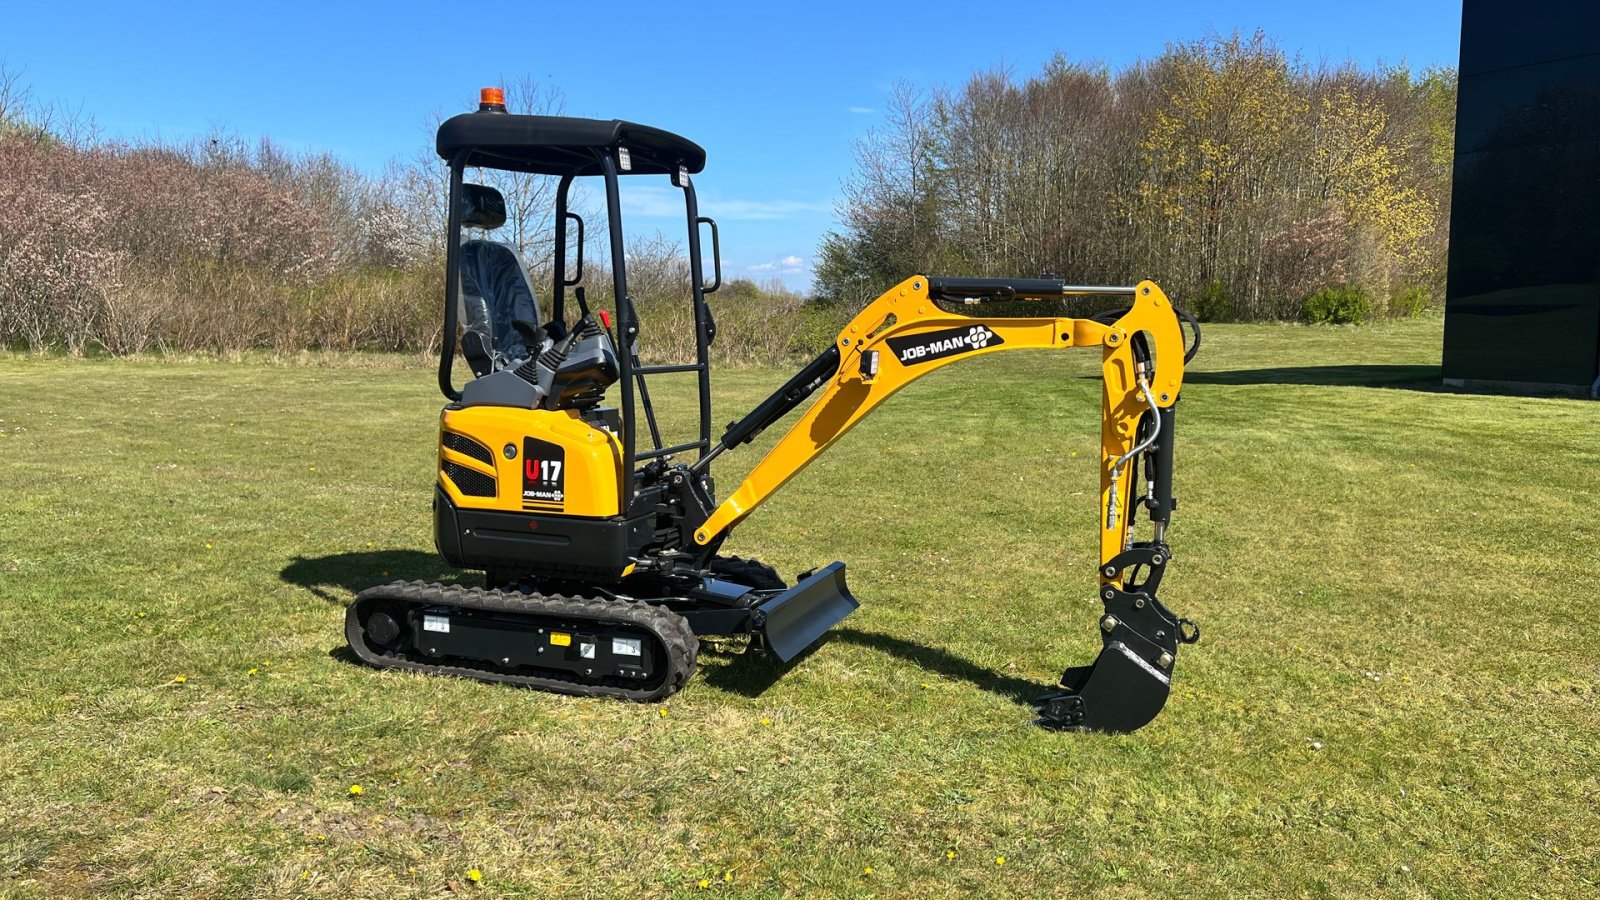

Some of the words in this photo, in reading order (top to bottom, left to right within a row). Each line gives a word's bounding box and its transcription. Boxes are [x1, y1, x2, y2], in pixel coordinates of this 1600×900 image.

[900, 336, 964, 361] JOB-MAN
[526, 459, 562, 481] U17
[523, 490, 552, 498] JOB-MAN
